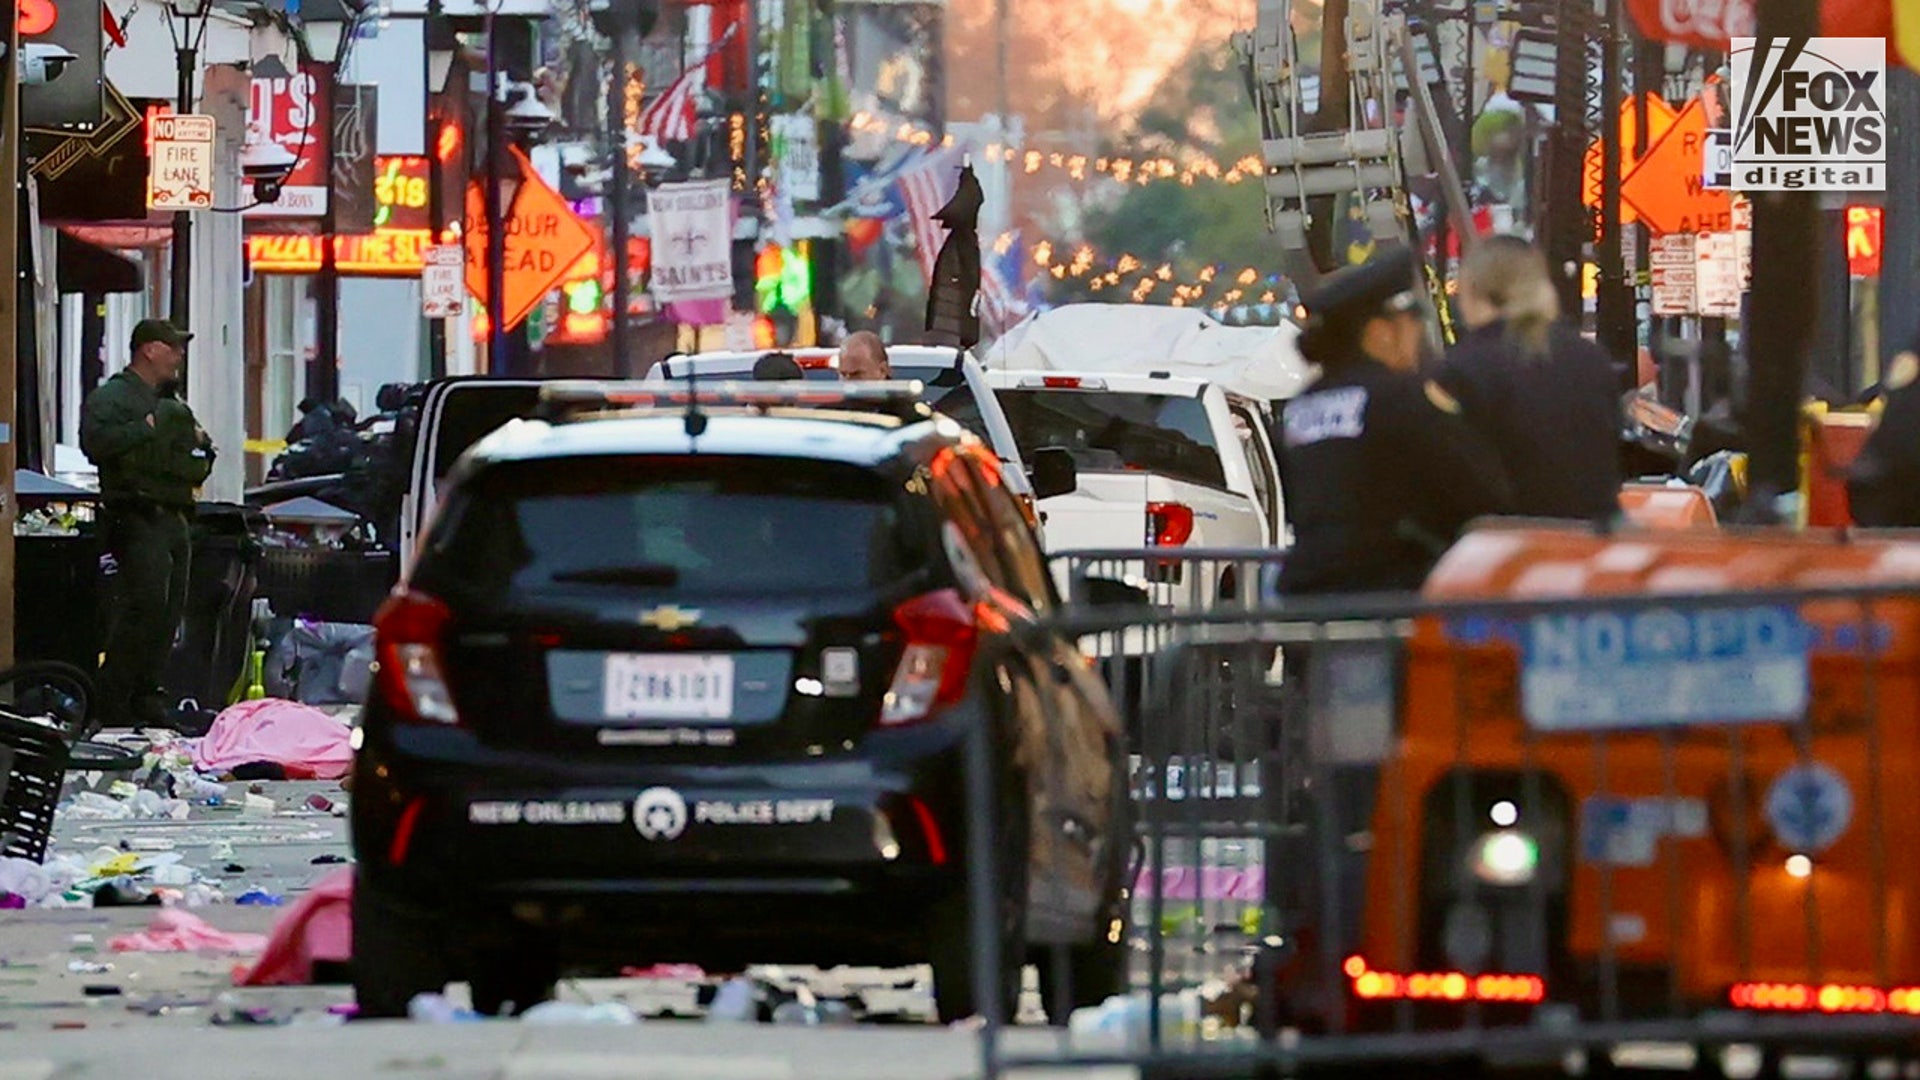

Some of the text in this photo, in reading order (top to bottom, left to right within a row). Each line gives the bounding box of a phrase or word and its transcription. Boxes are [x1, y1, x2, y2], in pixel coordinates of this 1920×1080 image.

[155, 119, 174, 139] NO
[167, 147, 198, 162] FIRE
[164, 167, 200, 182] LANE
[251, 235, 310, 260] PIZZA
[655, 262, 729, 286] SAINTS
[470, 800, 833, 823] NEW ORLEANS POLICE DEPT
